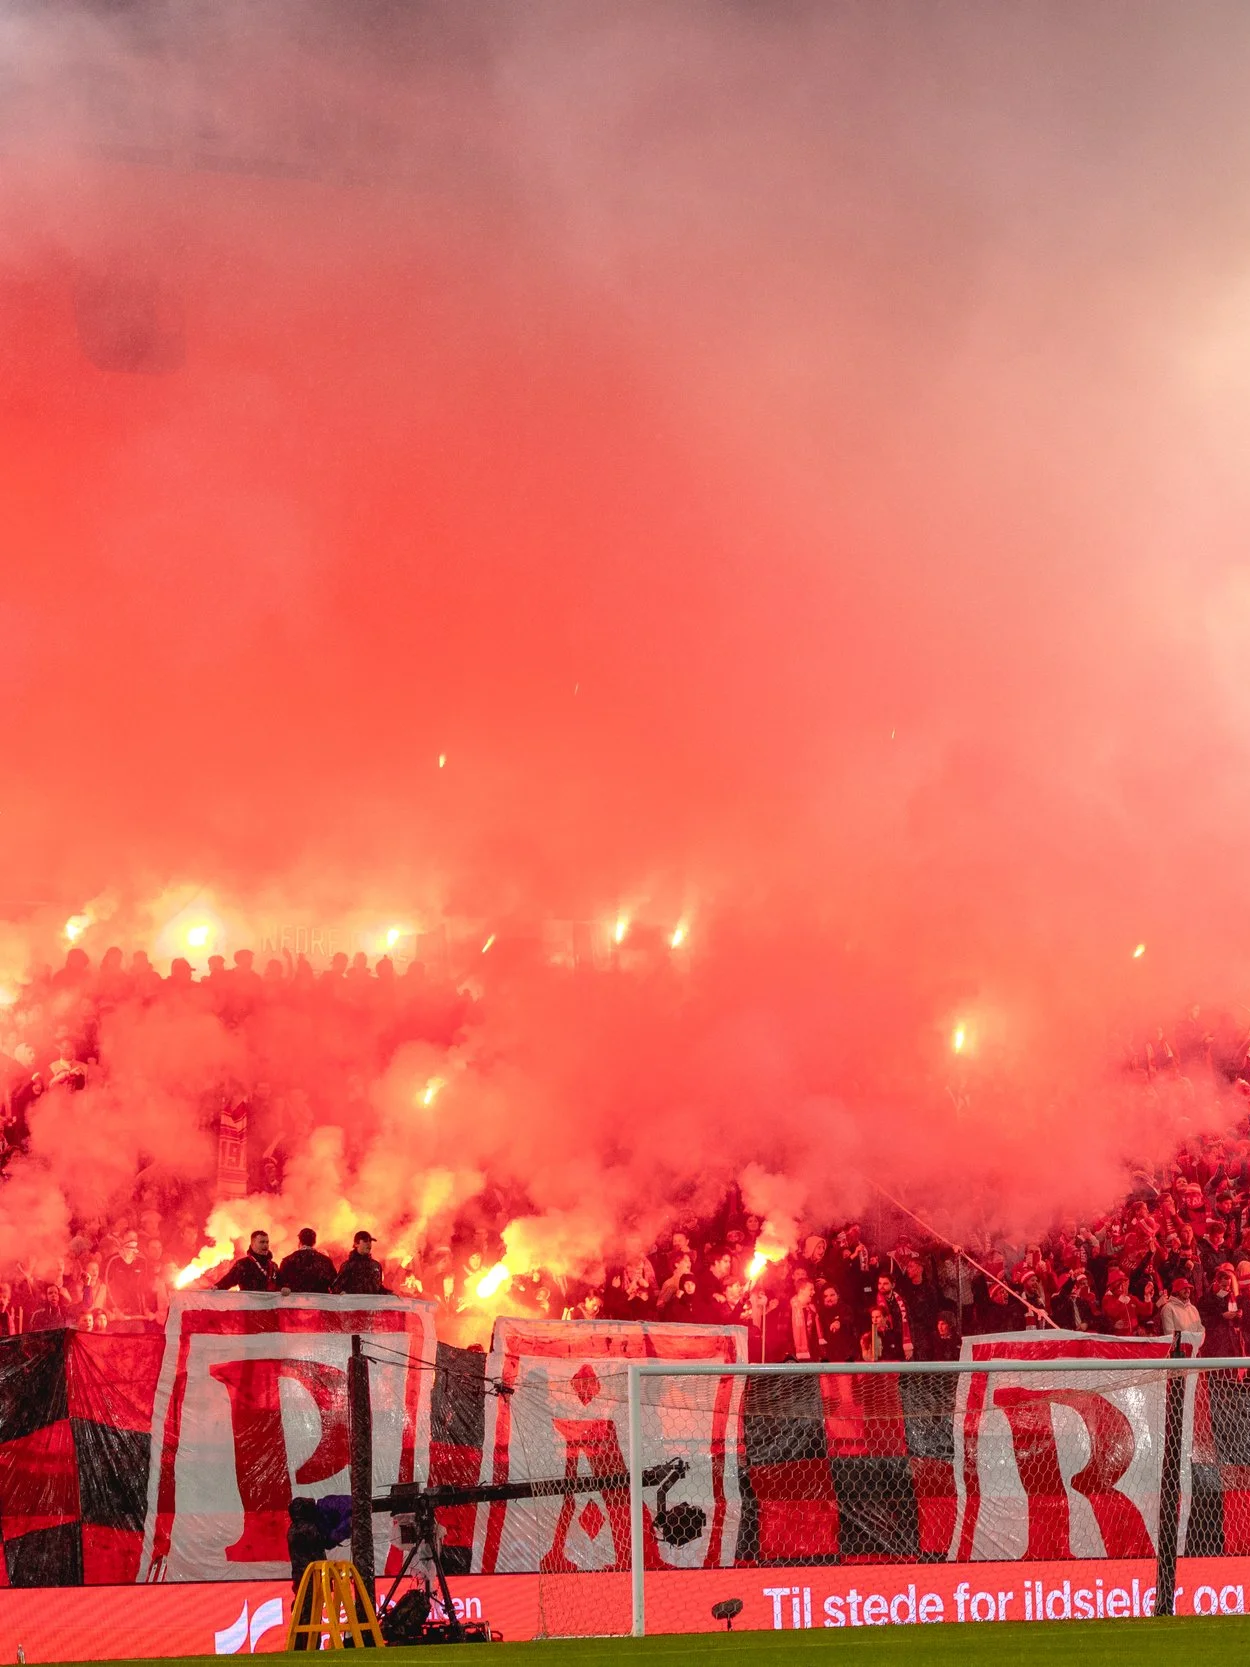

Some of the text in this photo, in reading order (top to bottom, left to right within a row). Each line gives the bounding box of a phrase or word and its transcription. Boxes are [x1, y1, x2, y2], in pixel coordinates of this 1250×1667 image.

[763, 1586, 811, 1630] Til
[823, 1583, 944, 1627] stede
[953, 1582, 1013, 1623] for
[1193, 1584, 1244, 1616] og
